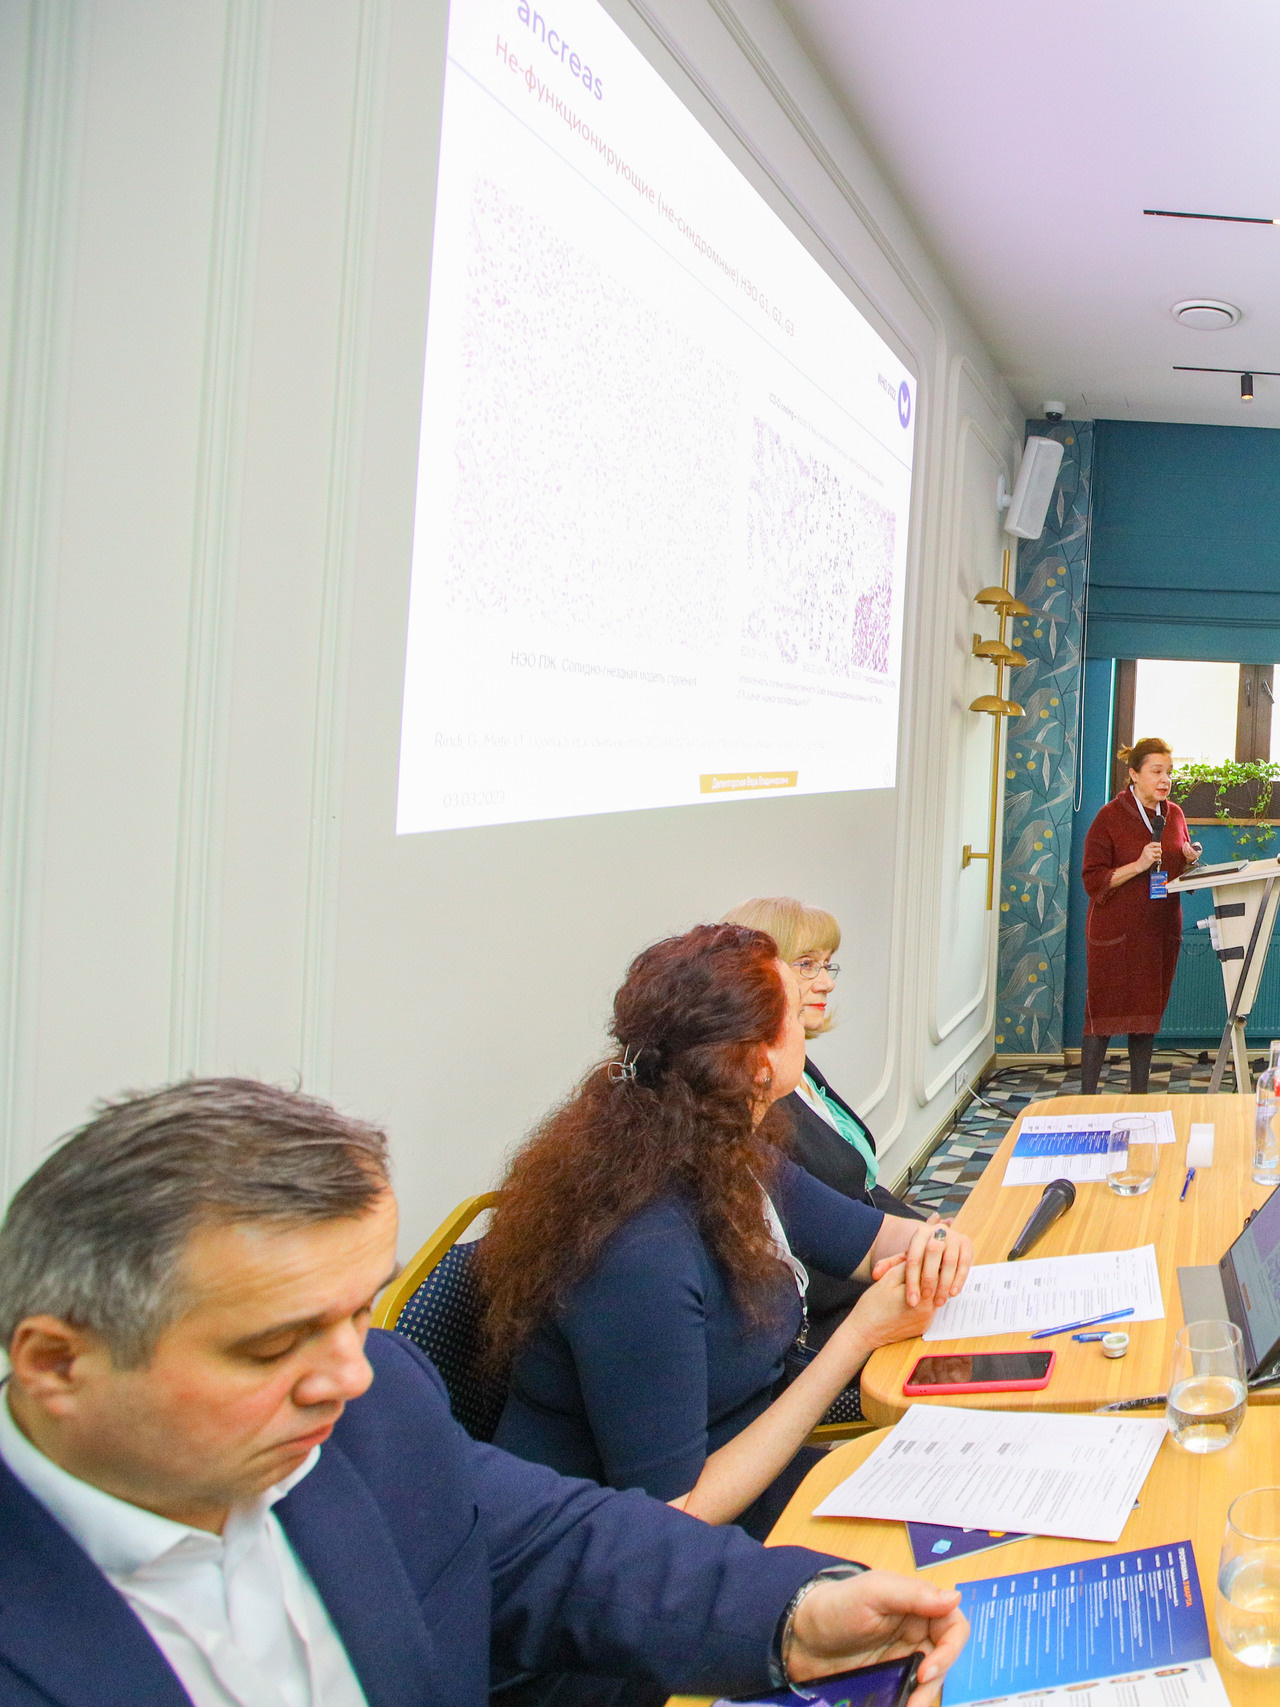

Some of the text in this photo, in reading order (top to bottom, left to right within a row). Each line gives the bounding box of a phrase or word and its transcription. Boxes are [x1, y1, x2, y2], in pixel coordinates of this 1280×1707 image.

[496, 34, 656, 204] Не-функционирующие
[510, 651, 536, 668] НЭО
[443, 791, 505, 808] 03.03.2023
